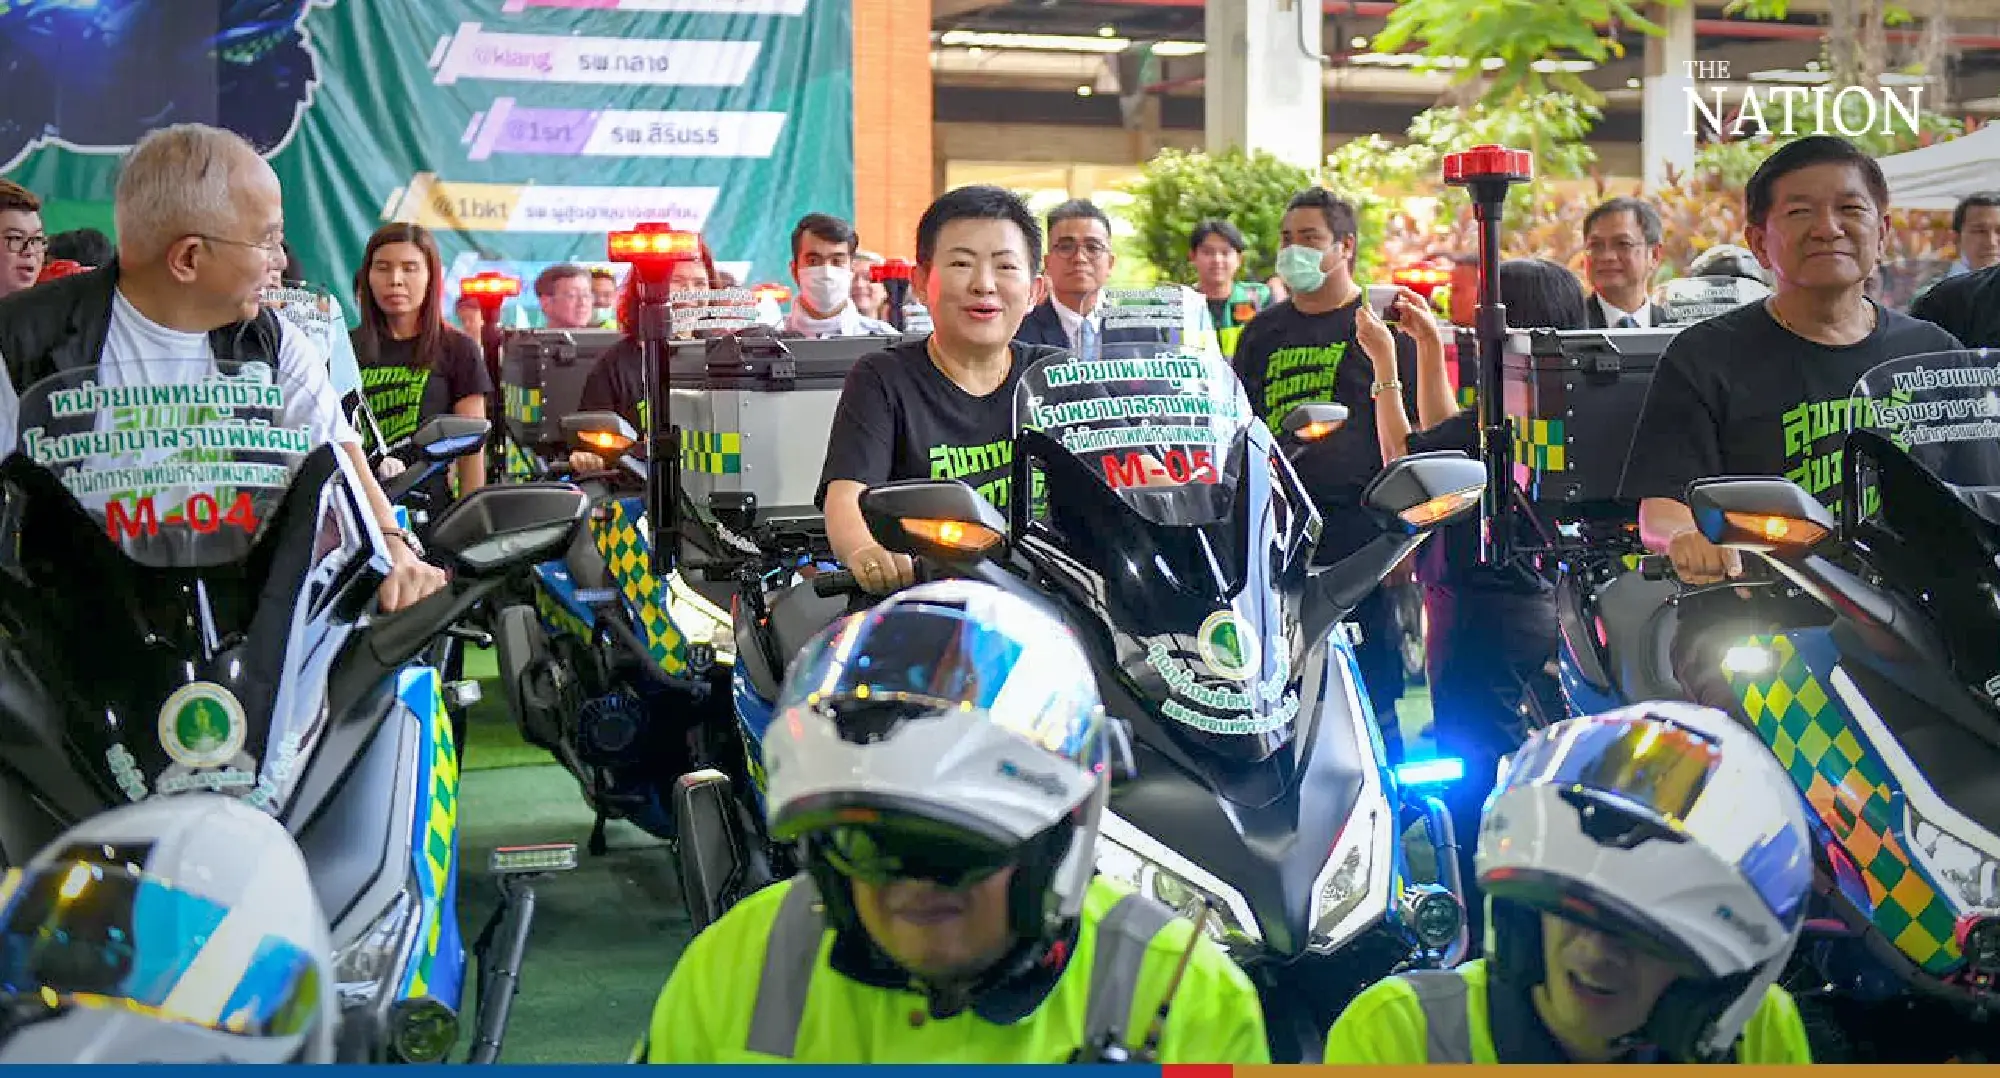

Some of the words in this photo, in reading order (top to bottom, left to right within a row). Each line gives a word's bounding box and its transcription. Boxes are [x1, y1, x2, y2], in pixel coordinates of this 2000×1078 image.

[52, 375, 284, 416] หน่วยแพทย์กู้ชีวิต
[24, 420, 312, 463] โรงพยาบาลราชพิพัฒน์
[1102, 450, 1217, 488] M-05
[105, 492, 261, 542] M-04
